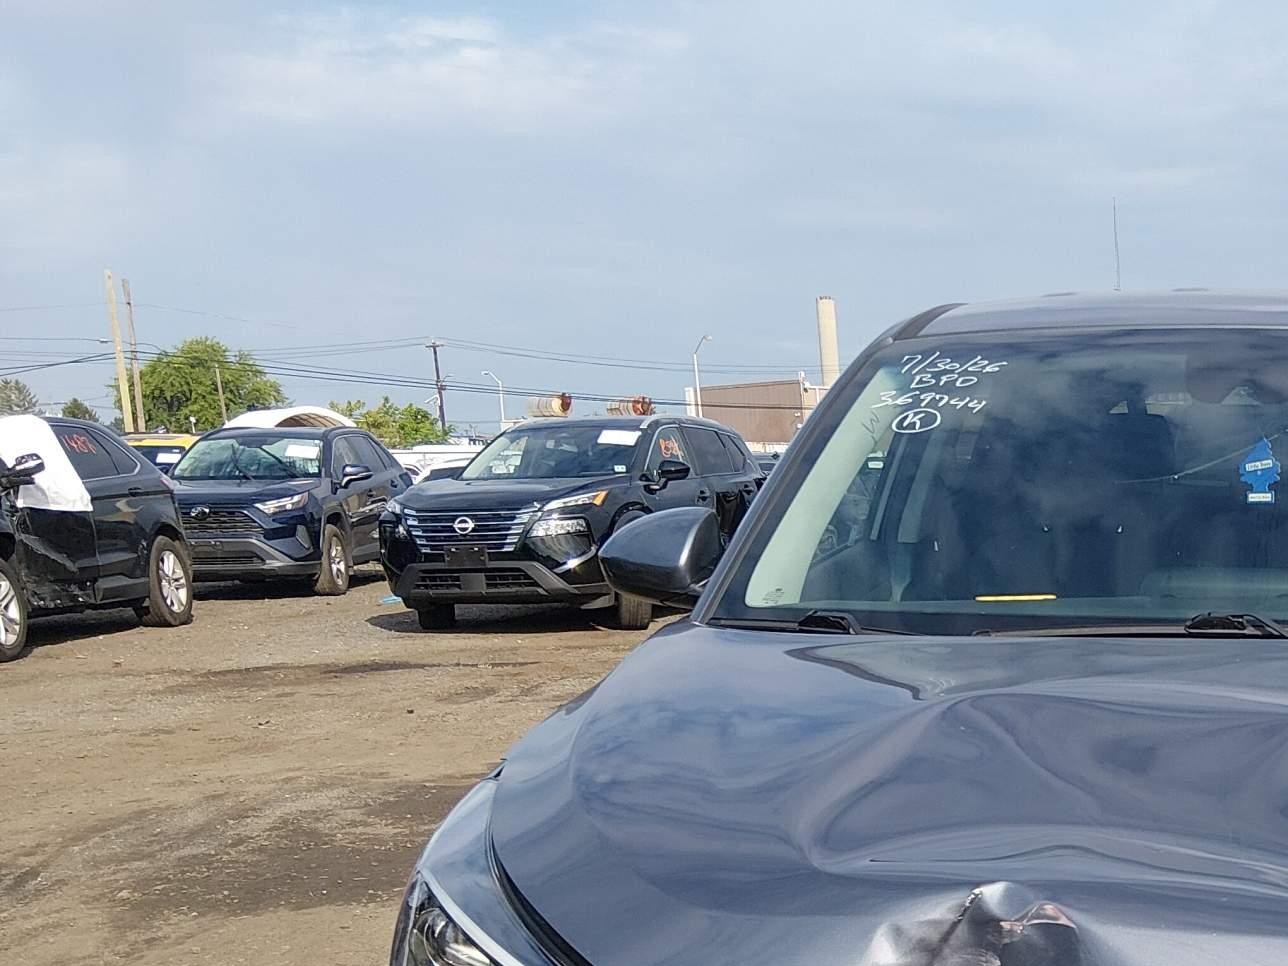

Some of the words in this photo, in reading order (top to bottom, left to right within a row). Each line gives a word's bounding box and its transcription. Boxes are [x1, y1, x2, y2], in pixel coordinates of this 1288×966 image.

[900, 351, 1008, 374] 7/30/26
[870, 390, 987, 414] 369744
[902, 411, 926, 431] K
